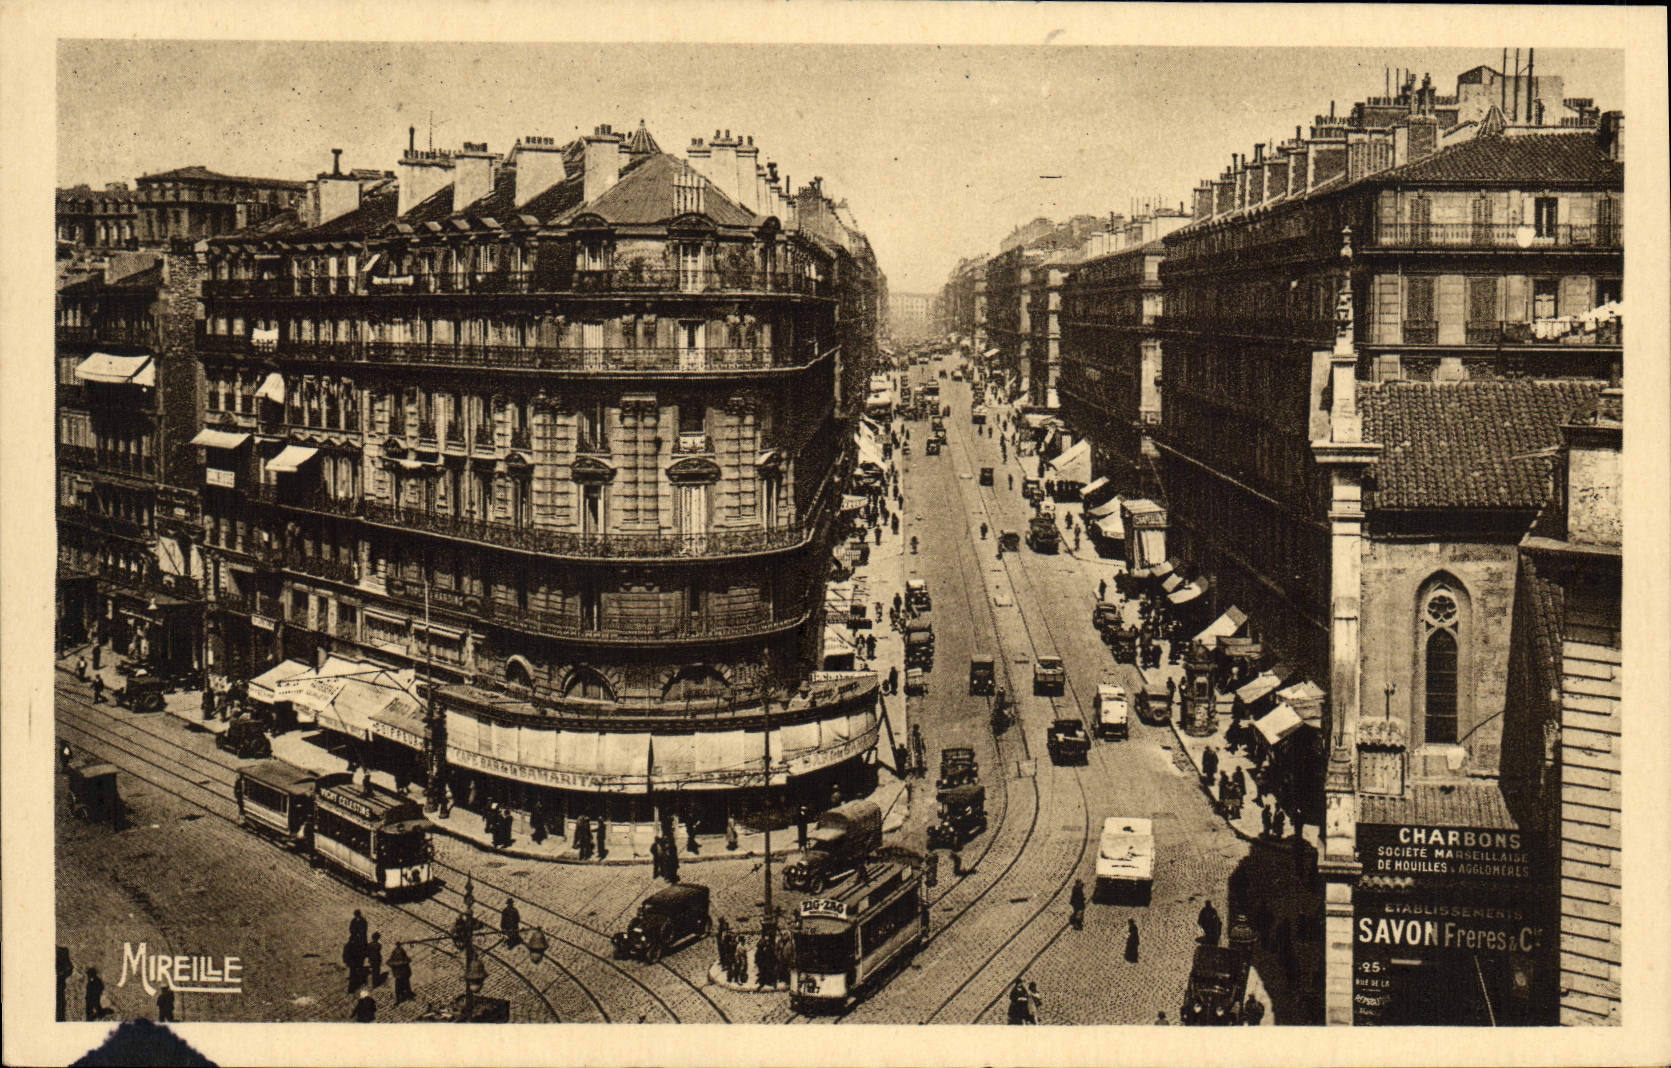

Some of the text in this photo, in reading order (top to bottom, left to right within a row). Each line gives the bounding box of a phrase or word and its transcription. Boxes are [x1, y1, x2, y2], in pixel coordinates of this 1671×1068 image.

[1399, 827, 1521, 849] CHARBONS
[1434, 849, 1529, 863] MARSEILLAISE
[1377, 859, 1391, 871] DE
[1395, 860, 1447, 873] HOUILLES
[802, 900, 844, 914] ZIG-ZAG
[1358, 917, 1439, 946] SAVON
